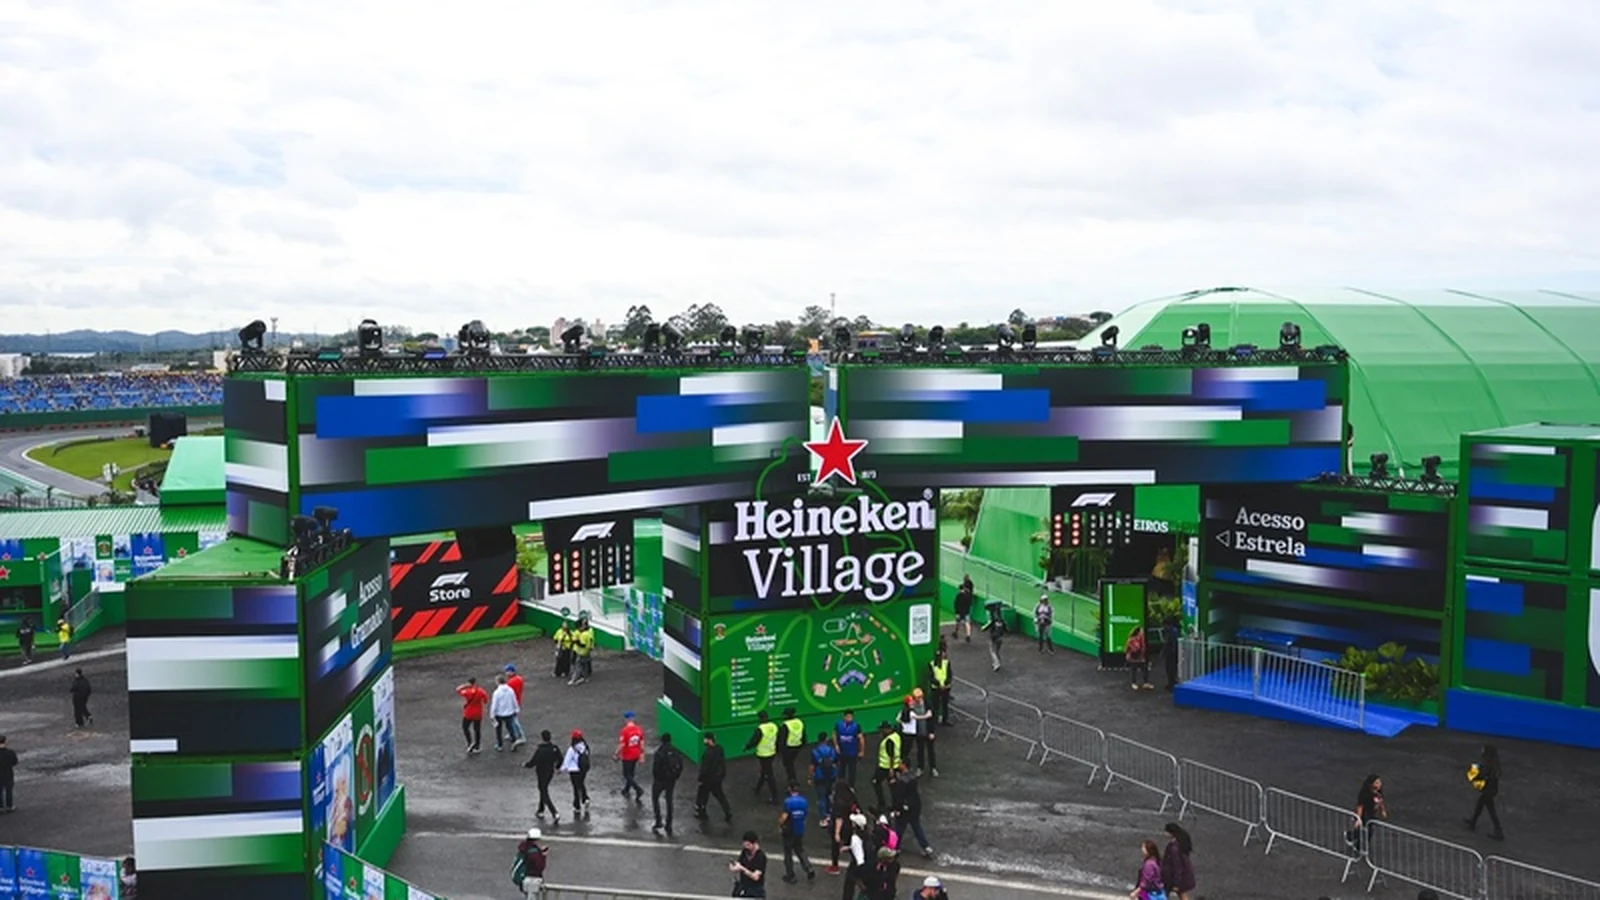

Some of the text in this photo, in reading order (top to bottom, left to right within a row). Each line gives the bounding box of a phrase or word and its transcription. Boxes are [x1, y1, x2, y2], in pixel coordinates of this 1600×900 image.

[733, 496, 933, 541] Heineken
[1235, 507, 1306, 531] Acesso
[1235, 531, 1307, 557] Estrela
[743, 543, 925, 601] Village
[429, 586, 471, 602] Store
